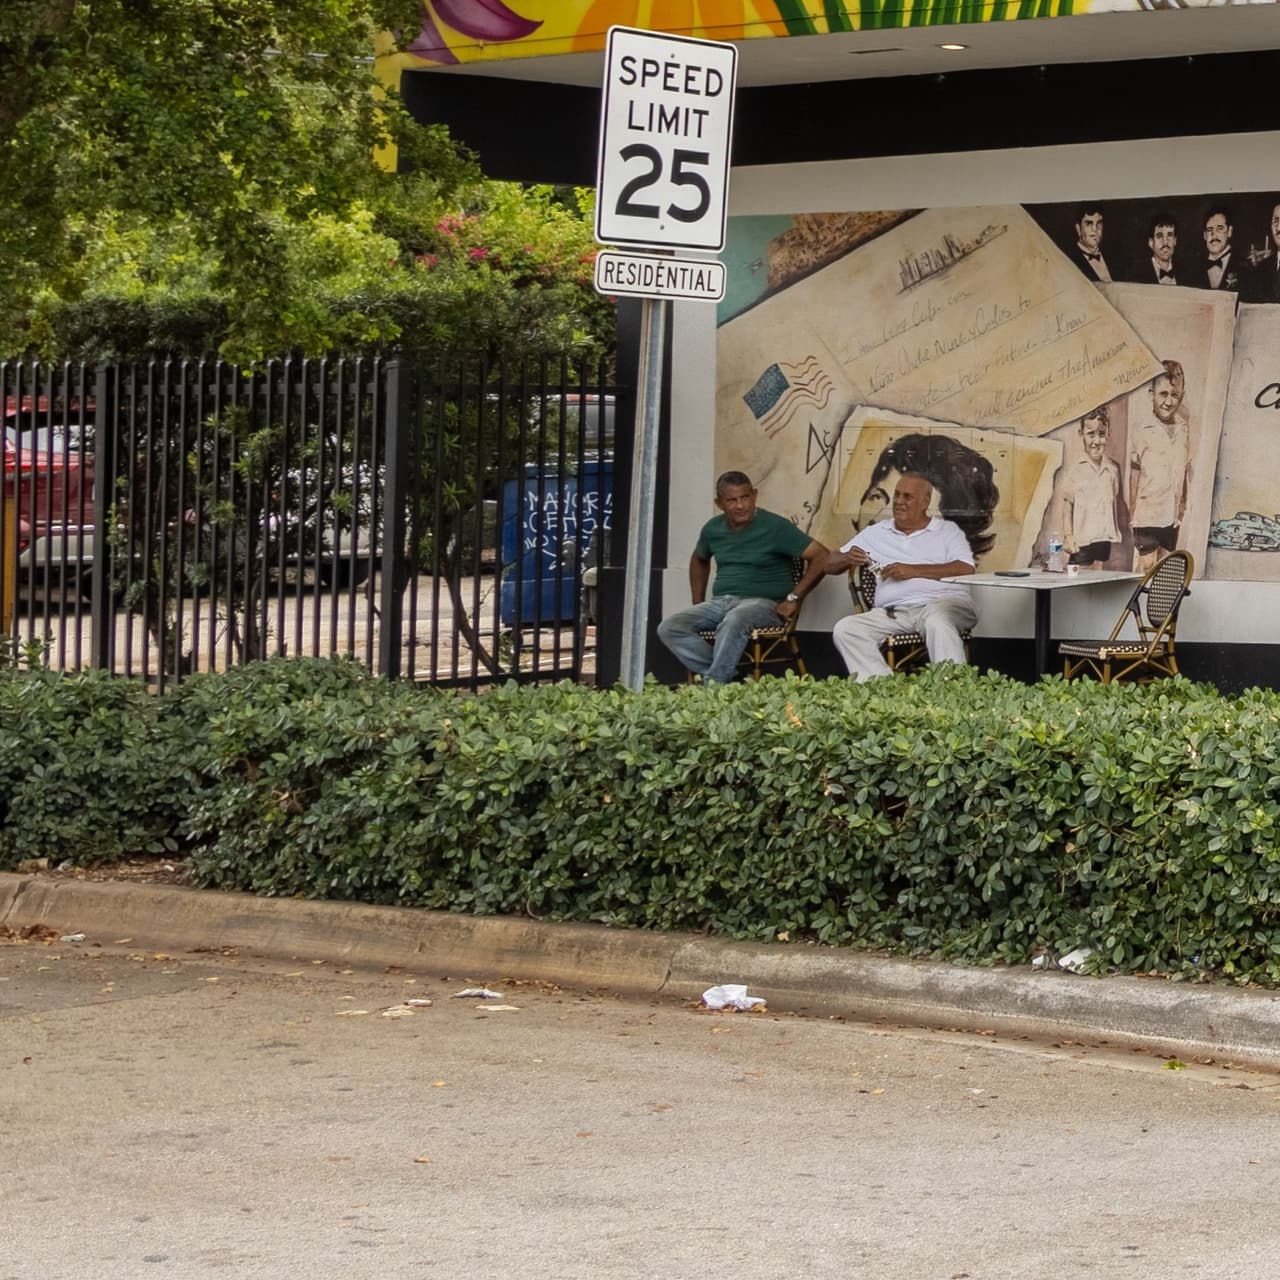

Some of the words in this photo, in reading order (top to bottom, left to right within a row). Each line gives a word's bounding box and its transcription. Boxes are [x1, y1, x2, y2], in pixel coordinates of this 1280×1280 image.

[618, 55, 724, 98] SPEED
[627, 100, 710, 138] LIMIT
[614, 142, 712, 223] 25
[603, 260, 717, 292] RESIDENTIAL
